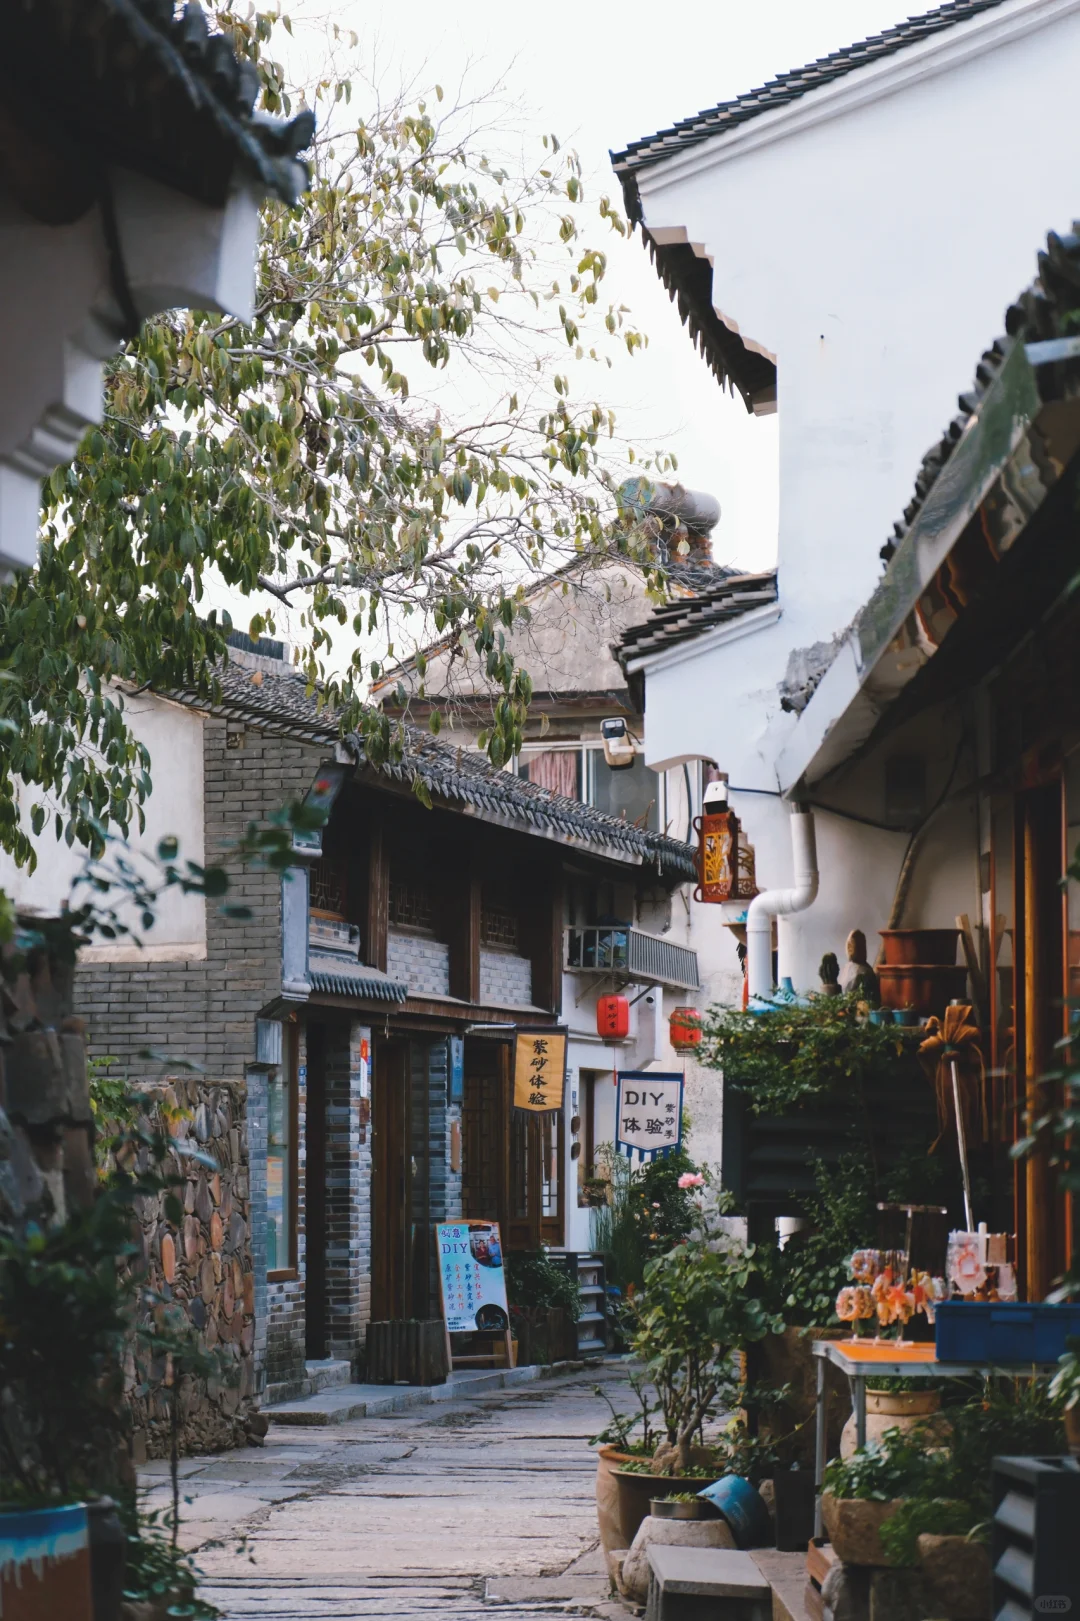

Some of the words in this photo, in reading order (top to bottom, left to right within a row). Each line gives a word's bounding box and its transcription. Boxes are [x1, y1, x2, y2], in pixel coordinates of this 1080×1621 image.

[528, 1039, 548, 1105] 紫砂体验
[624, 1090, 664, 1106] DIY
[622, 1116, 665, 1134] 体验
[664, 1103, 676, 1139] 紫砂季
[441, 1228, 461, 1239] 创意
[442, 1243, 468, 1254] DIY
